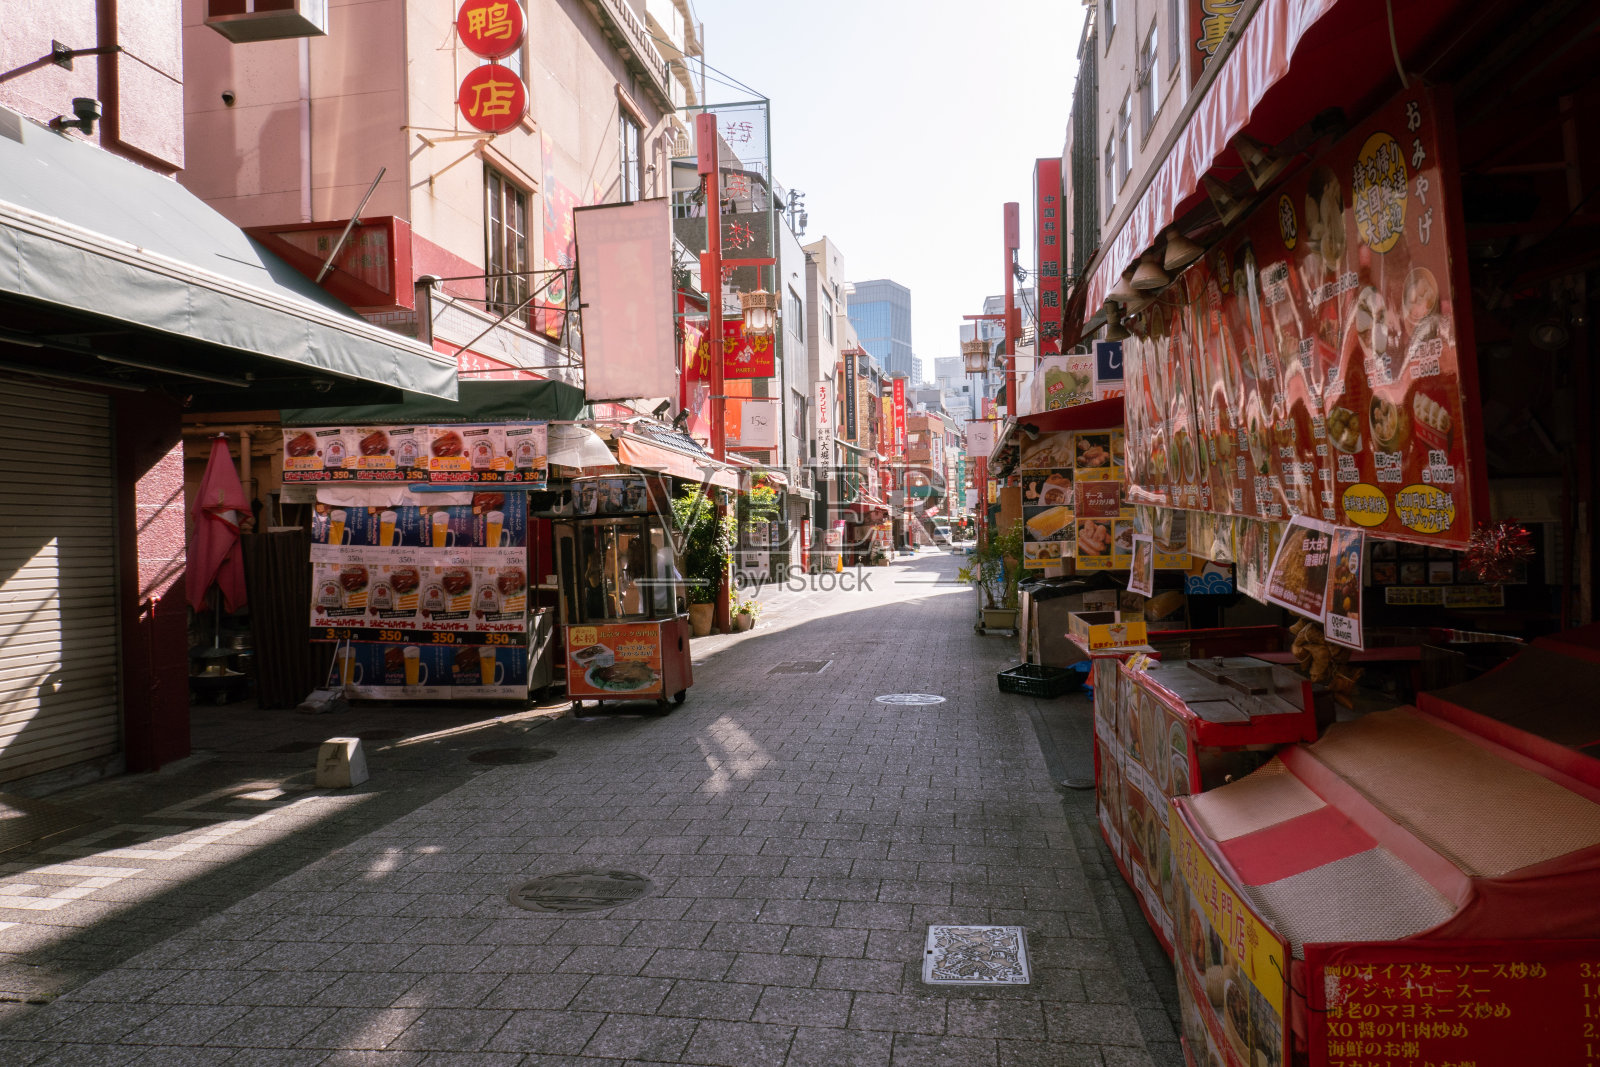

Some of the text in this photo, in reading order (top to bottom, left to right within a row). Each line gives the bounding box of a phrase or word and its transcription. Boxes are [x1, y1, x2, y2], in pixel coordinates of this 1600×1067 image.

[1353, 141, 1400, 194] 持ち帰り
[1406, 101, 1433, 245] おみやげ
[1355, 168, 1408, 224] 全国発送
[819, 387, 828, 424] キリンビール
[820, 442, 830, 479] 大堀商店
[1395, 492, 1453, 512] 1,500円以上無料
[1400, 509, 1450, 530] 保冷パック付き
[573, 633, 597, 644] 本格
[1327, 983, 1492, 1000] ンジャオロースー
[1326, 1002, 1512, 1019] 海老のマヨネーズ炒め
[1326, 1022, 1353, 1038] XO
[1327, 1041, 1420, 1058] 海鮮のお粥
